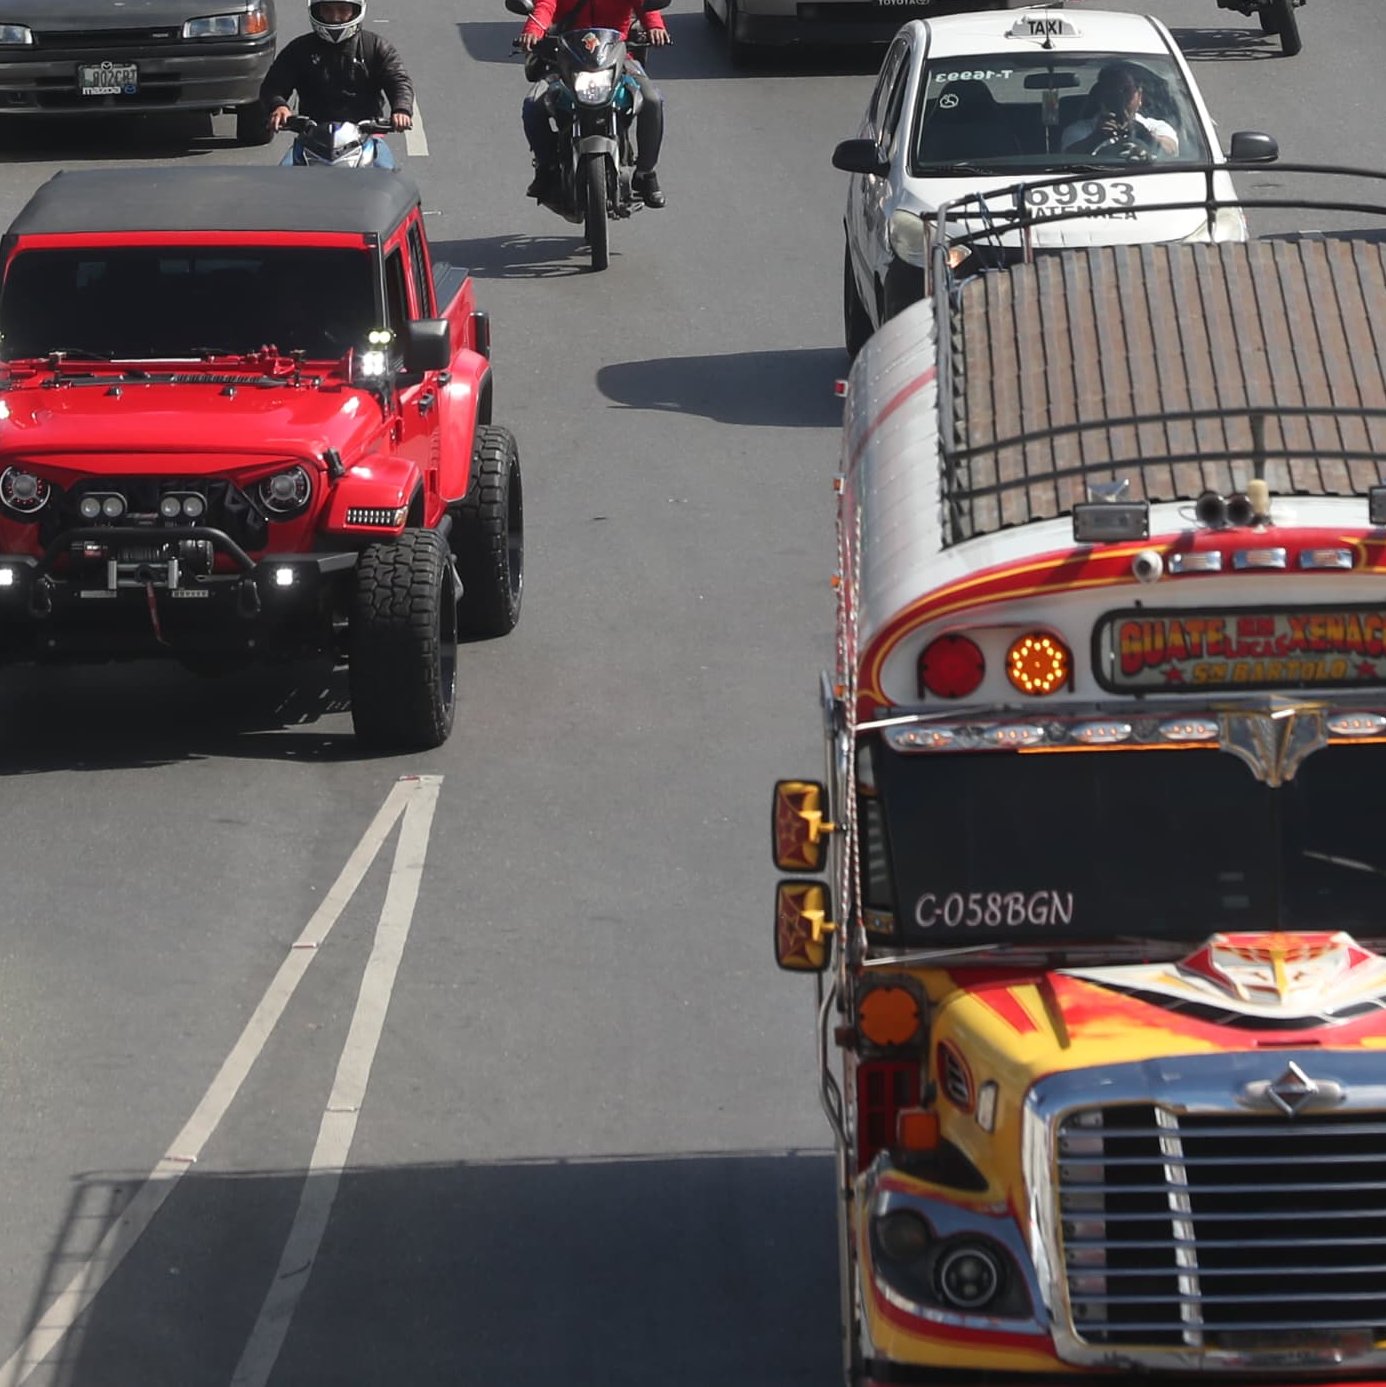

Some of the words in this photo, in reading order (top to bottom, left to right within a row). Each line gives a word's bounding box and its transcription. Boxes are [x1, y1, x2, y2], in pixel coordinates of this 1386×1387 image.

[1028, 20, 1063, 36] TAXI
[82, 86, 122, 95] mazda
[1119, 617, 1227, 676] GUATE
[1231, 658, 1349, 683] BARTOLO
[914, 890, 1074, 928] C-058BGN
